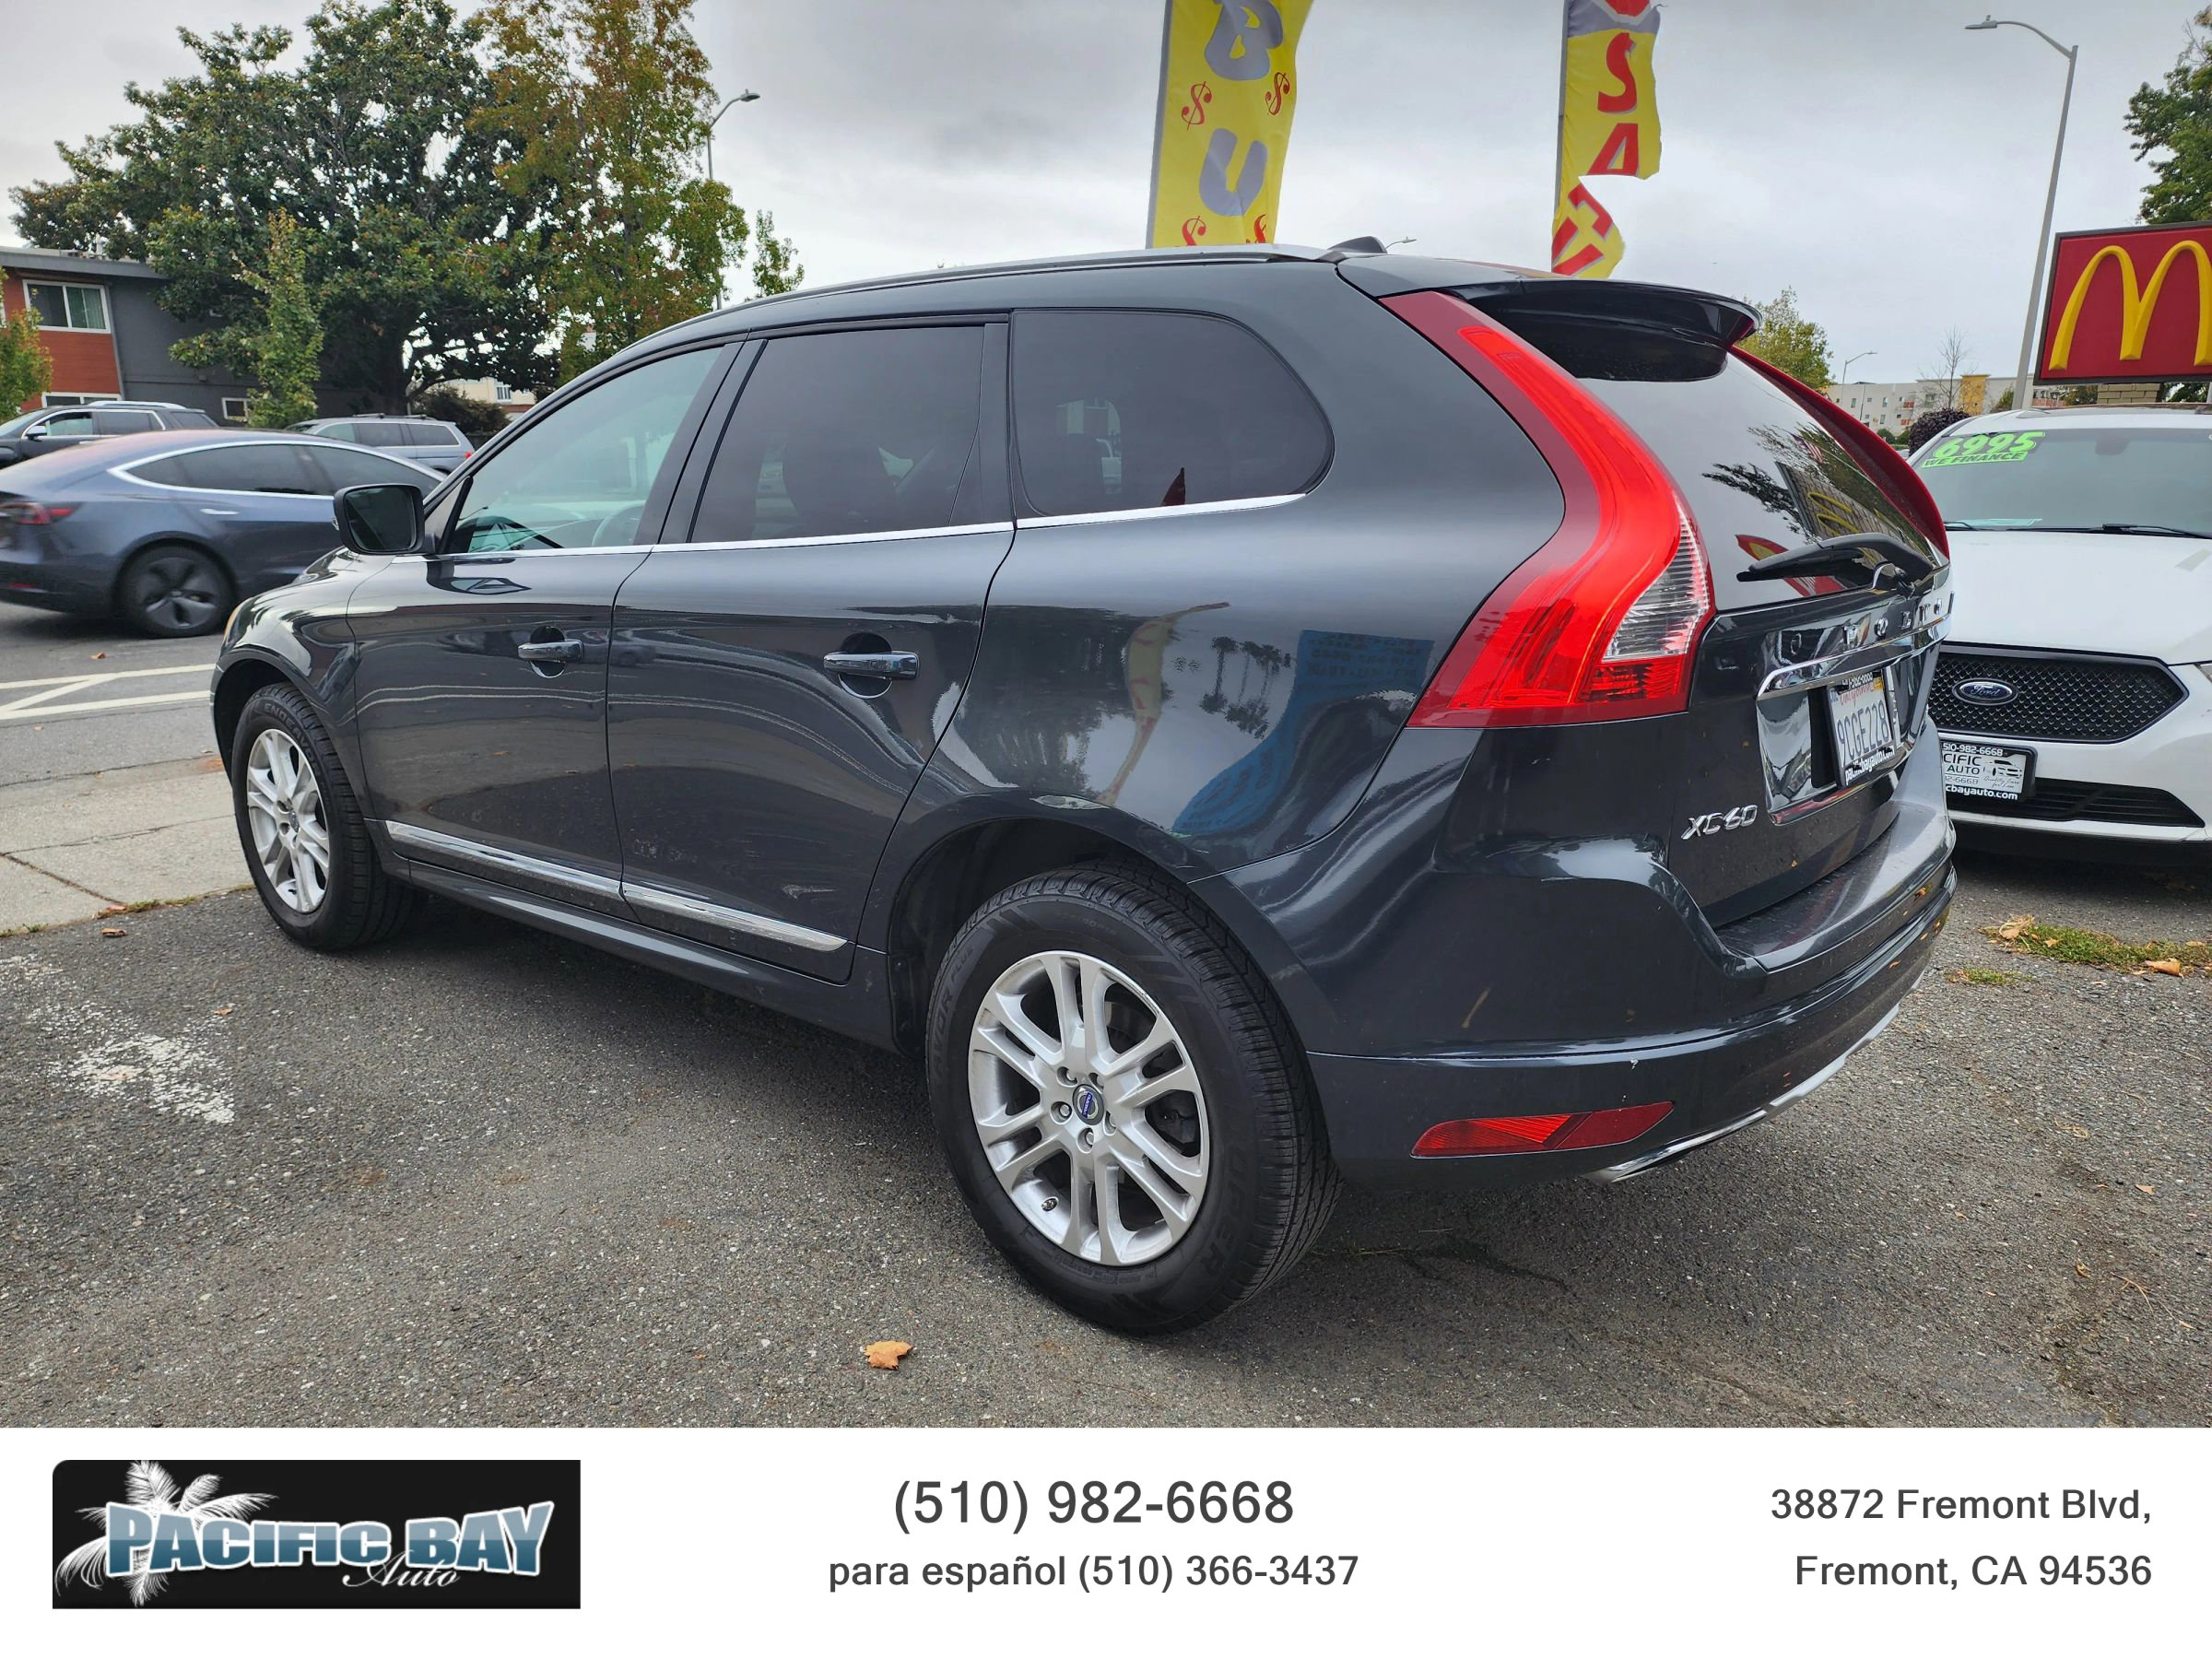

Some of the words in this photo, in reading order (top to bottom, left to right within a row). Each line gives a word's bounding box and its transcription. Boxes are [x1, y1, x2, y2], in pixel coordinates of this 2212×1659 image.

[1933, 431, 2046, 458] 6995
[1924, 457, 1947, 466] WE
[1950, 452, 2026, 464] FINANCE
[1971, 685, 2001, 697] Ford
[1942, 742, 2004, 757] 510-982-6668
[1947, 764, 1981, 775] AUTO
[1680, 804, 1759, 840] XC60
